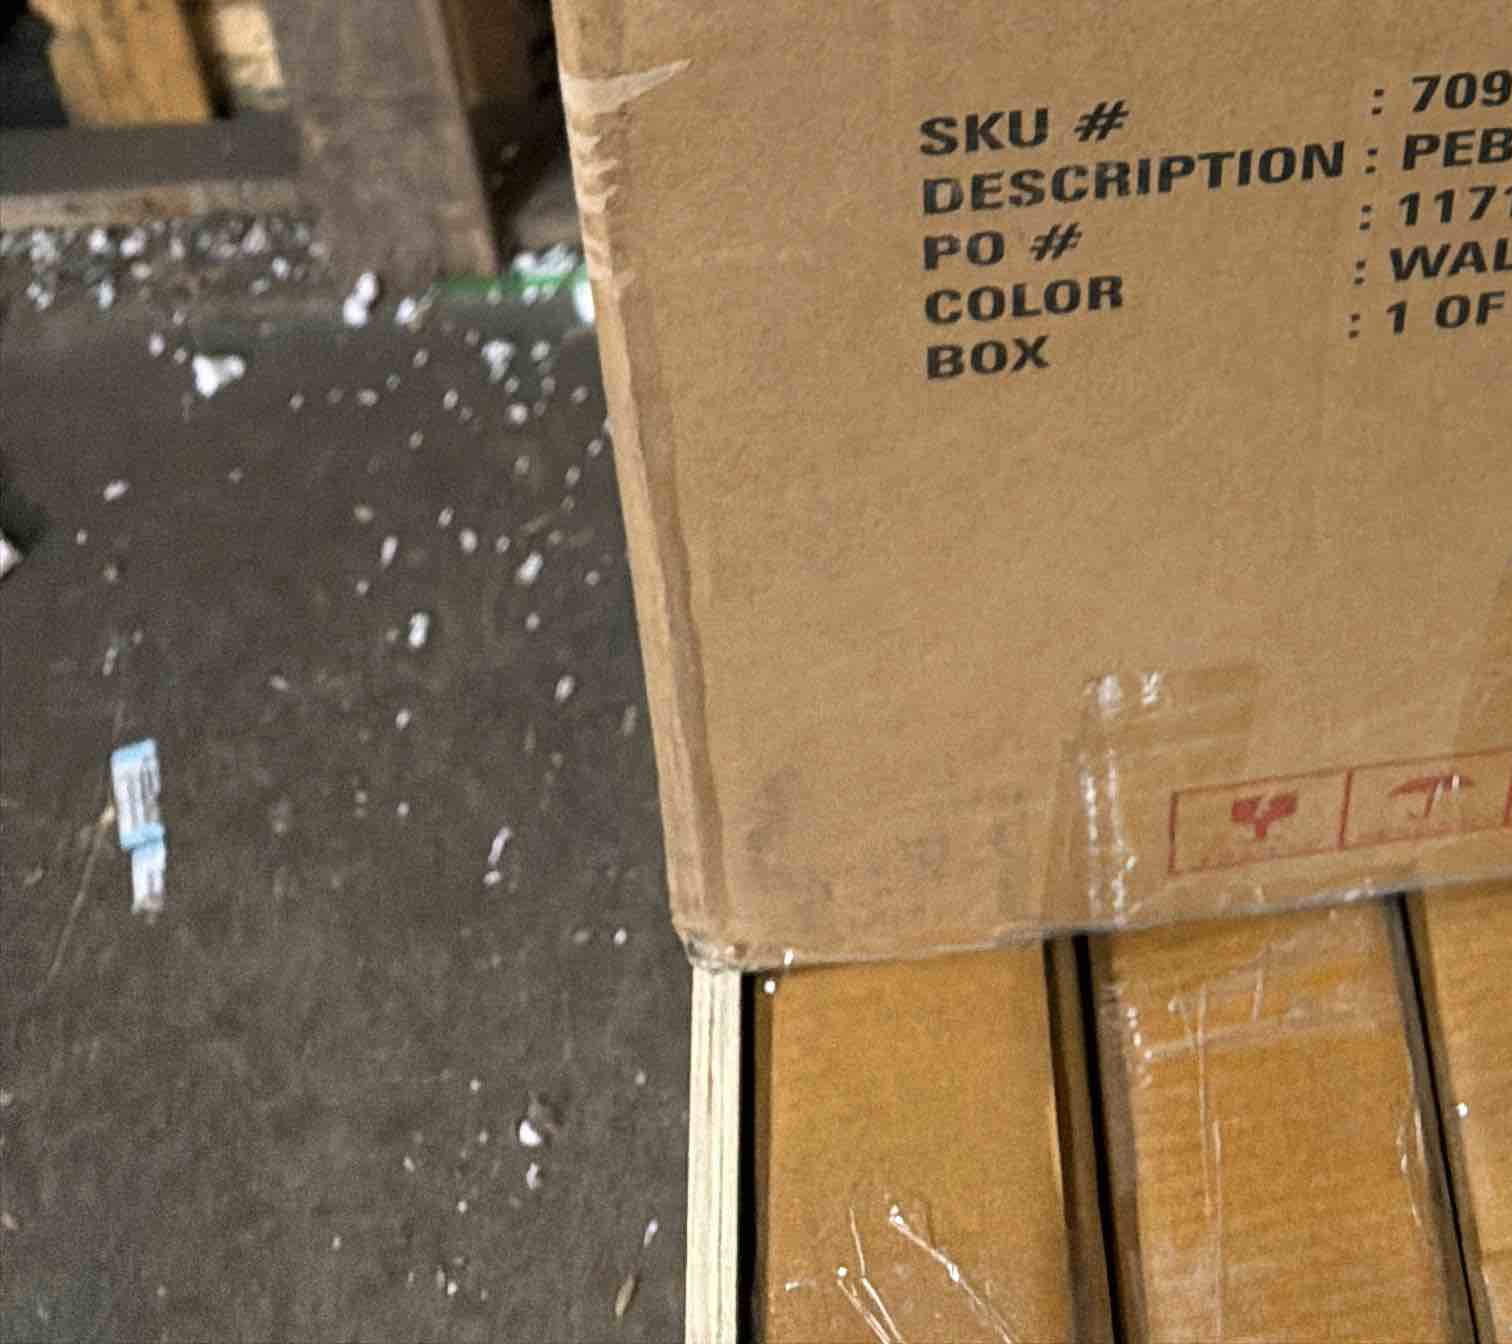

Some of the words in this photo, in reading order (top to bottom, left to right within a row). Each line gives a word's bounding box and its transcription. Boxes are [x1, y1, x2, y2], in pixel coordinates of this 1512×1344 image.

[919, 108, 1049, 156] SKU
[1073, 99, 1130, 143] #
[922, 140, 1345, 216] DESCRIPTION
[922, 230, 1006, 271] PO
[1028, 222, 1083, 263] #
[924, 275, 1124, 326] COLOR
[926, 335, 1050, 380] BOX
[1385, 300, 1408, 335] 1
[1434, 290, 1505, 329] OF
